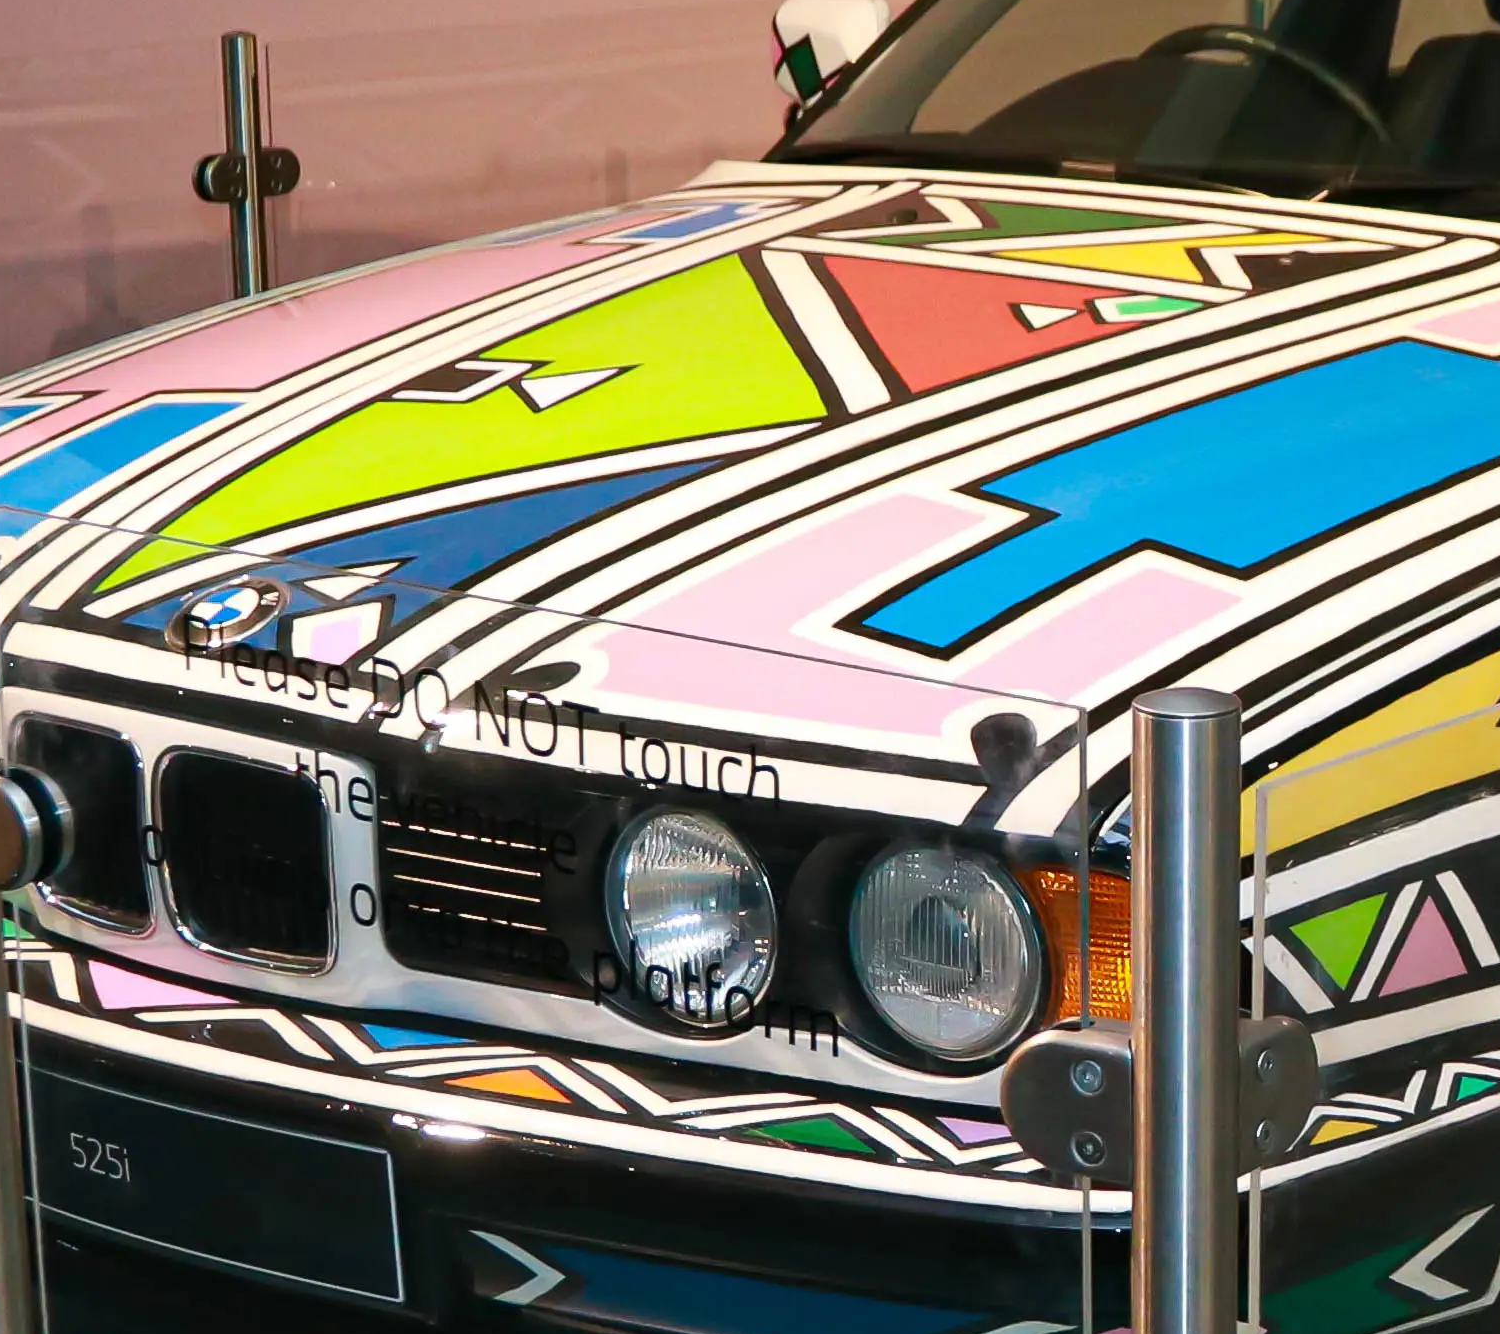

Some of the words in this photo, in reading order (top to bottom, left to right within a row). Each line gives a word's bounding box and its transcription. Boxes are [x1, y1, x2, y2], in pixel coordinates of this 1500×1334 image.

[183, 613, 351, 710] Please
[372, 656, 451, 732] DO
[474, 679, 601, 767] NOT
[617, 721, 783, 809] touch
[294, 750, 374, 821] the
[593, 939, 840, 1057] platform
[69, 1131, 131, 1183] 525i
